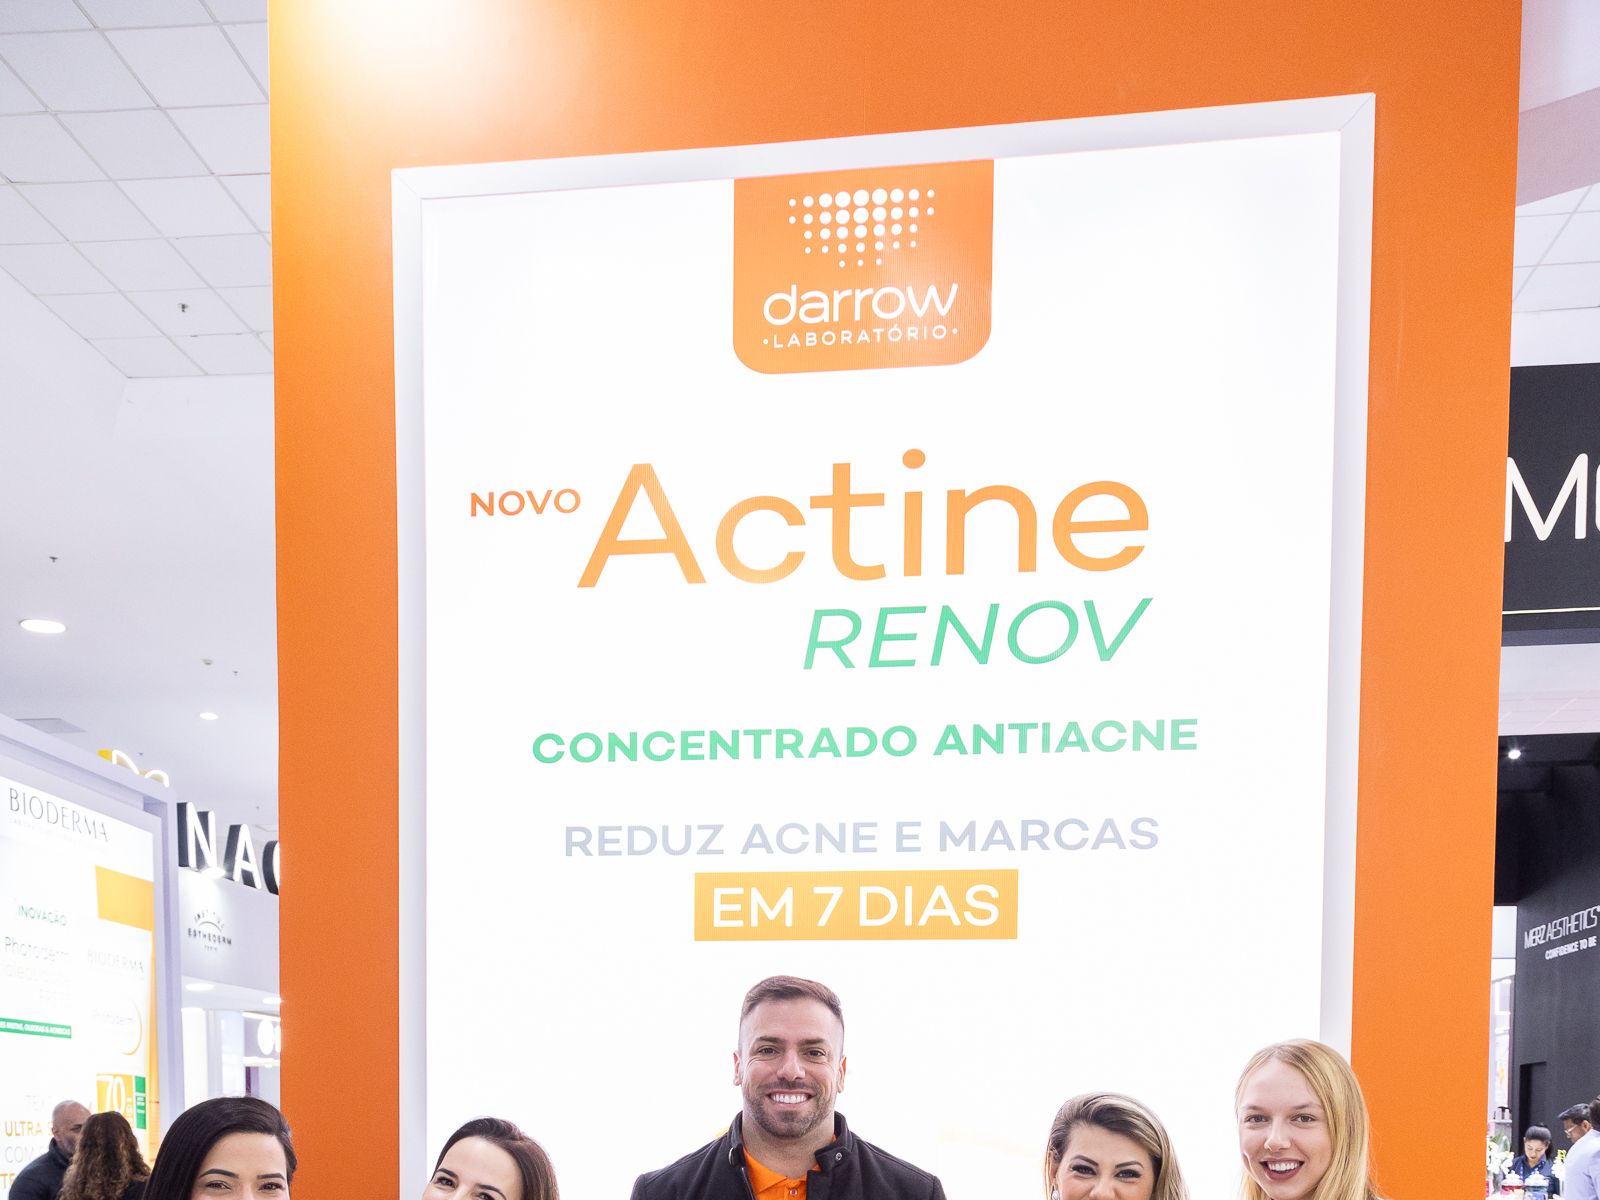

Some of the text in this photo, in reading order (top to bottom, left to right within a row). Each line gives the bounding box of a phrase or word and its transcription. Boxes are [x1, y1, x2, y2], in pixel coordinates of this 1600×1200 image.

[763, 283, 958, 325] darrow
[773, 324, 947, 348] LABORATÓRIO
[470, 488, 581, 517] NOVO
[577, 448, 1149, 588] Actine
[1504, 453, 1600, 543] M
[804, 597, 1154, 670] RENOV
[532, 719, 1198, 764] CONCENTRADO ANTIACNE
[9, 787, 109, 842] BIODERMA
[565, 816, 1159, 857] REDUZ ACNE E MARCAS
[713, 884, 1000, 927] EM 7 DIAS
[1524, 924, 1546, 949] MERZ
[4, 1121, 43, 1136] ULTRA
